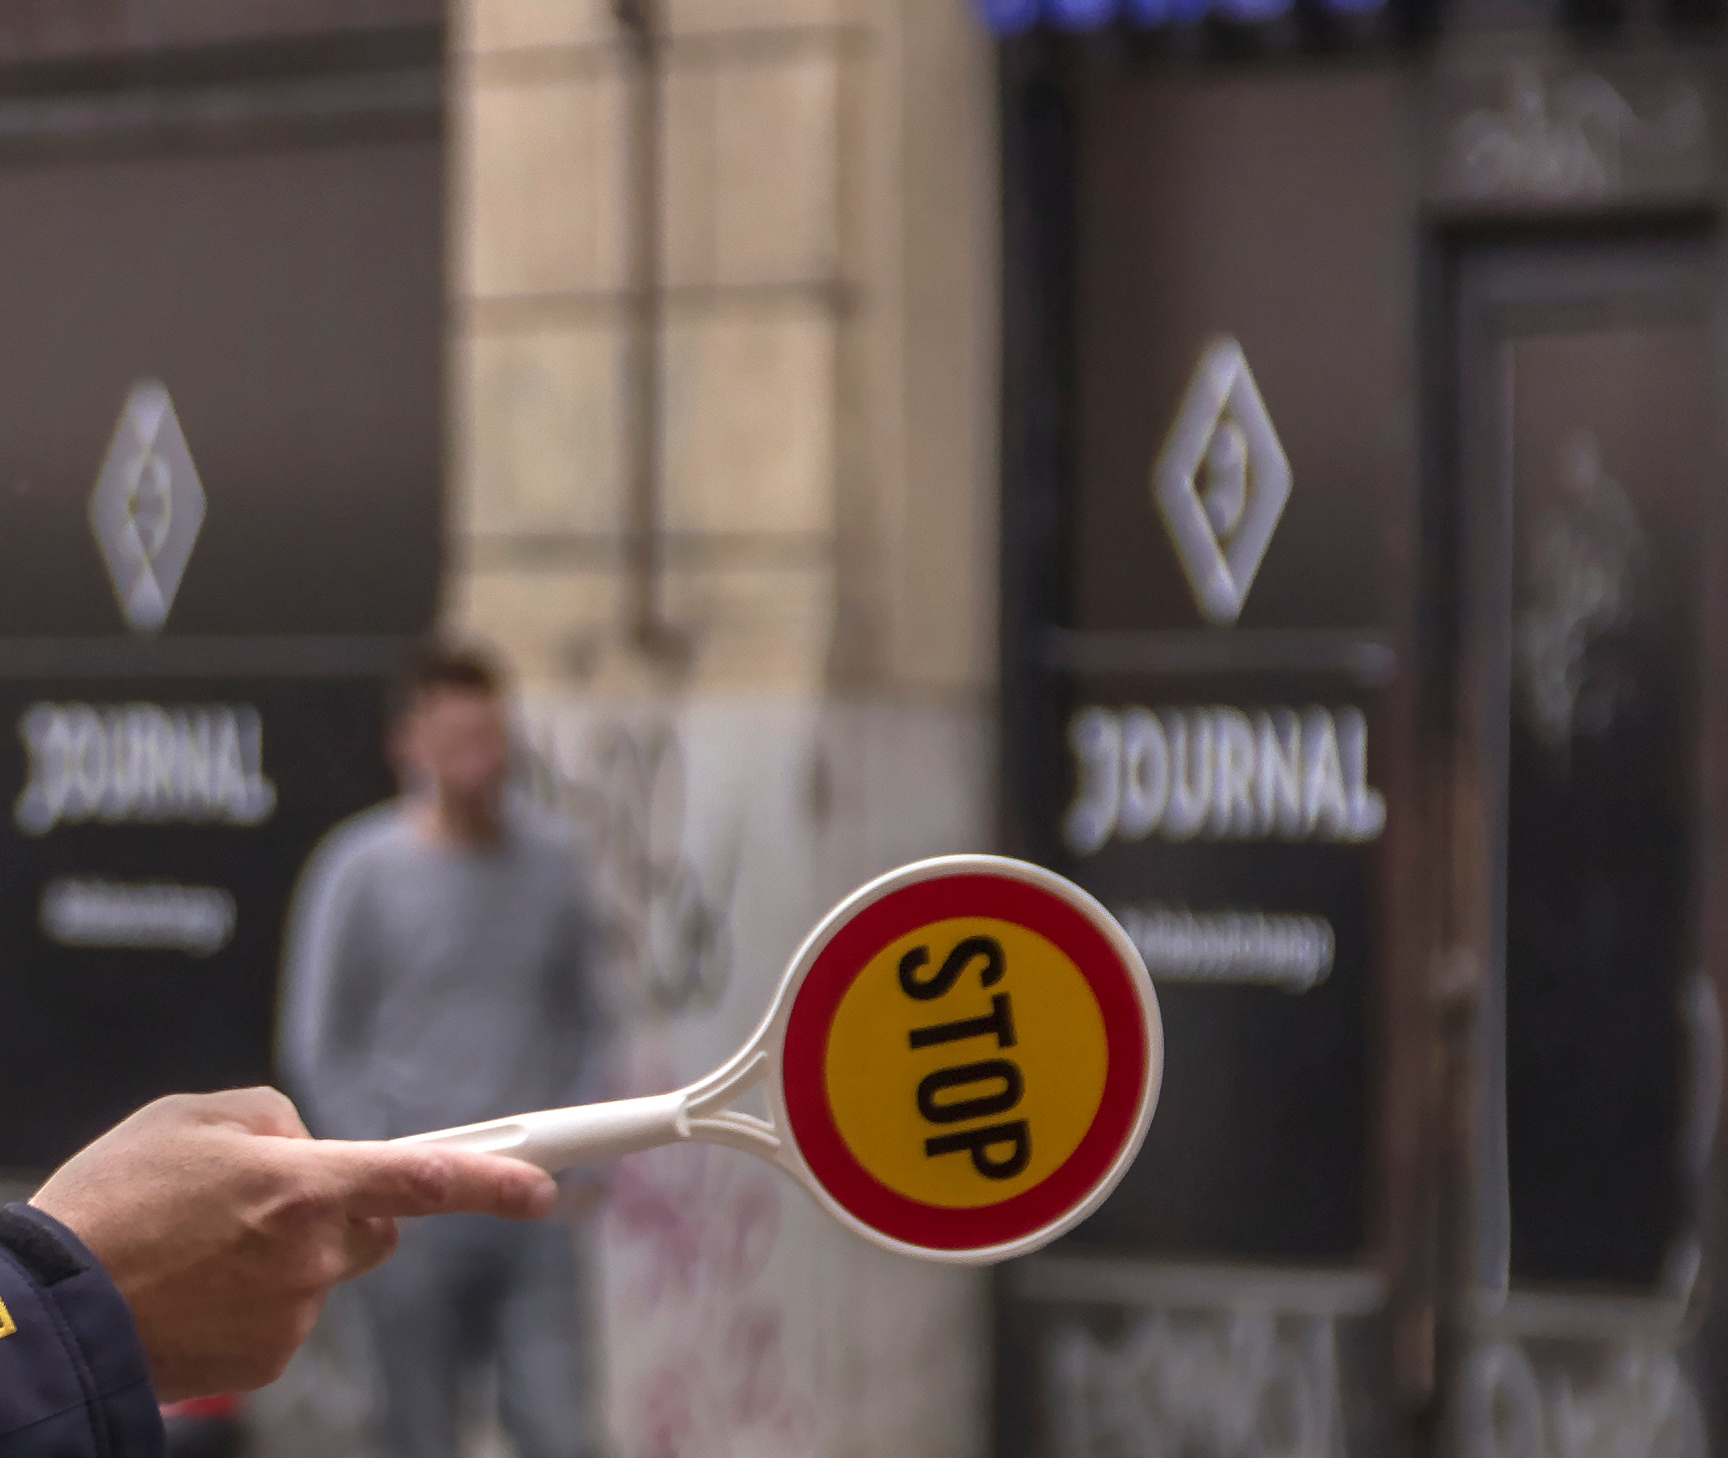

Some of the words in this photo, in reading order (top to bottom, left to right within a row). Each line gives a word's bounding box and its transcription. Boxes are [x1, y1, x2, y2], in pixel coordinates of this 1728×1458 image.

[15, 701, 277, 836] JOURNAL
[1063, 704, 1387, 857] JOURNAL
[896, 933, 1033, 1182] STOP
